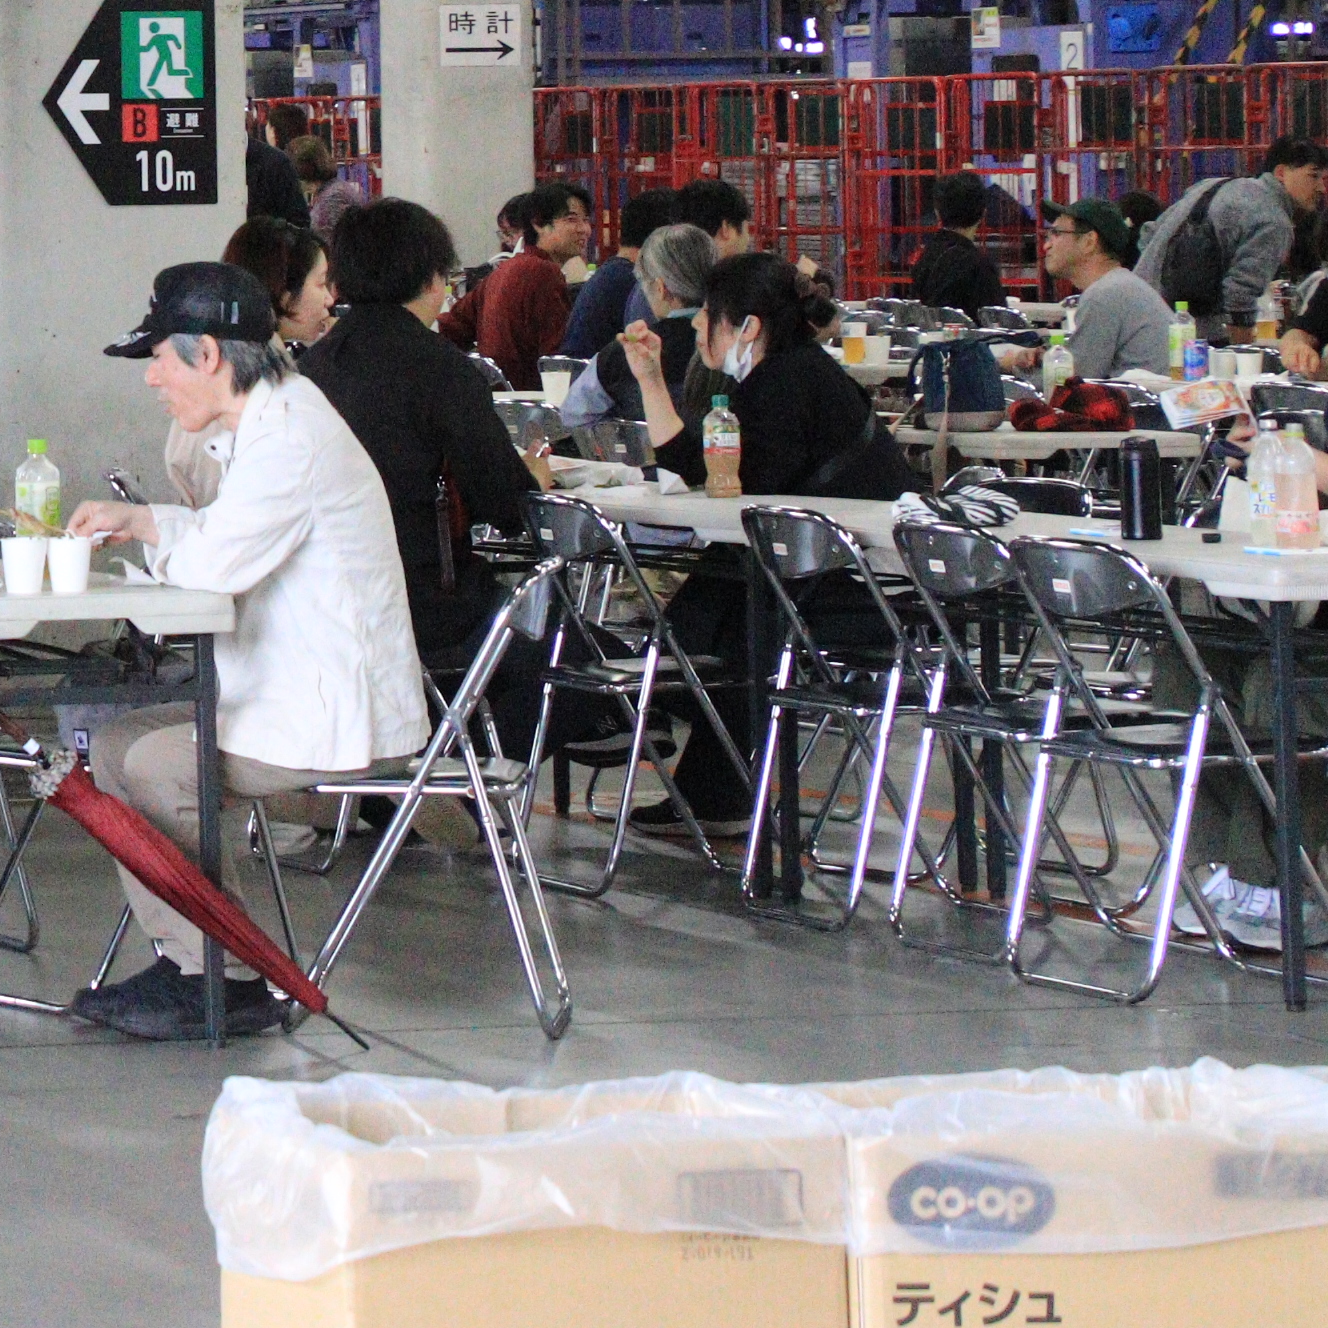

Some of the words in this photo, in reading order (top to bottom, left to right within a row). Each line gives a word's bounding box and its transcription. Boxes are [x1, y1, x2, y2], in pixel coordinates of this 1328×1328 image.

[448, 10, 515, 35] 時計
[133, 107, 147, 138] B
[165, 112, 200, 128] 避難
[891, 1282, 1063, 1327] ティシュ
